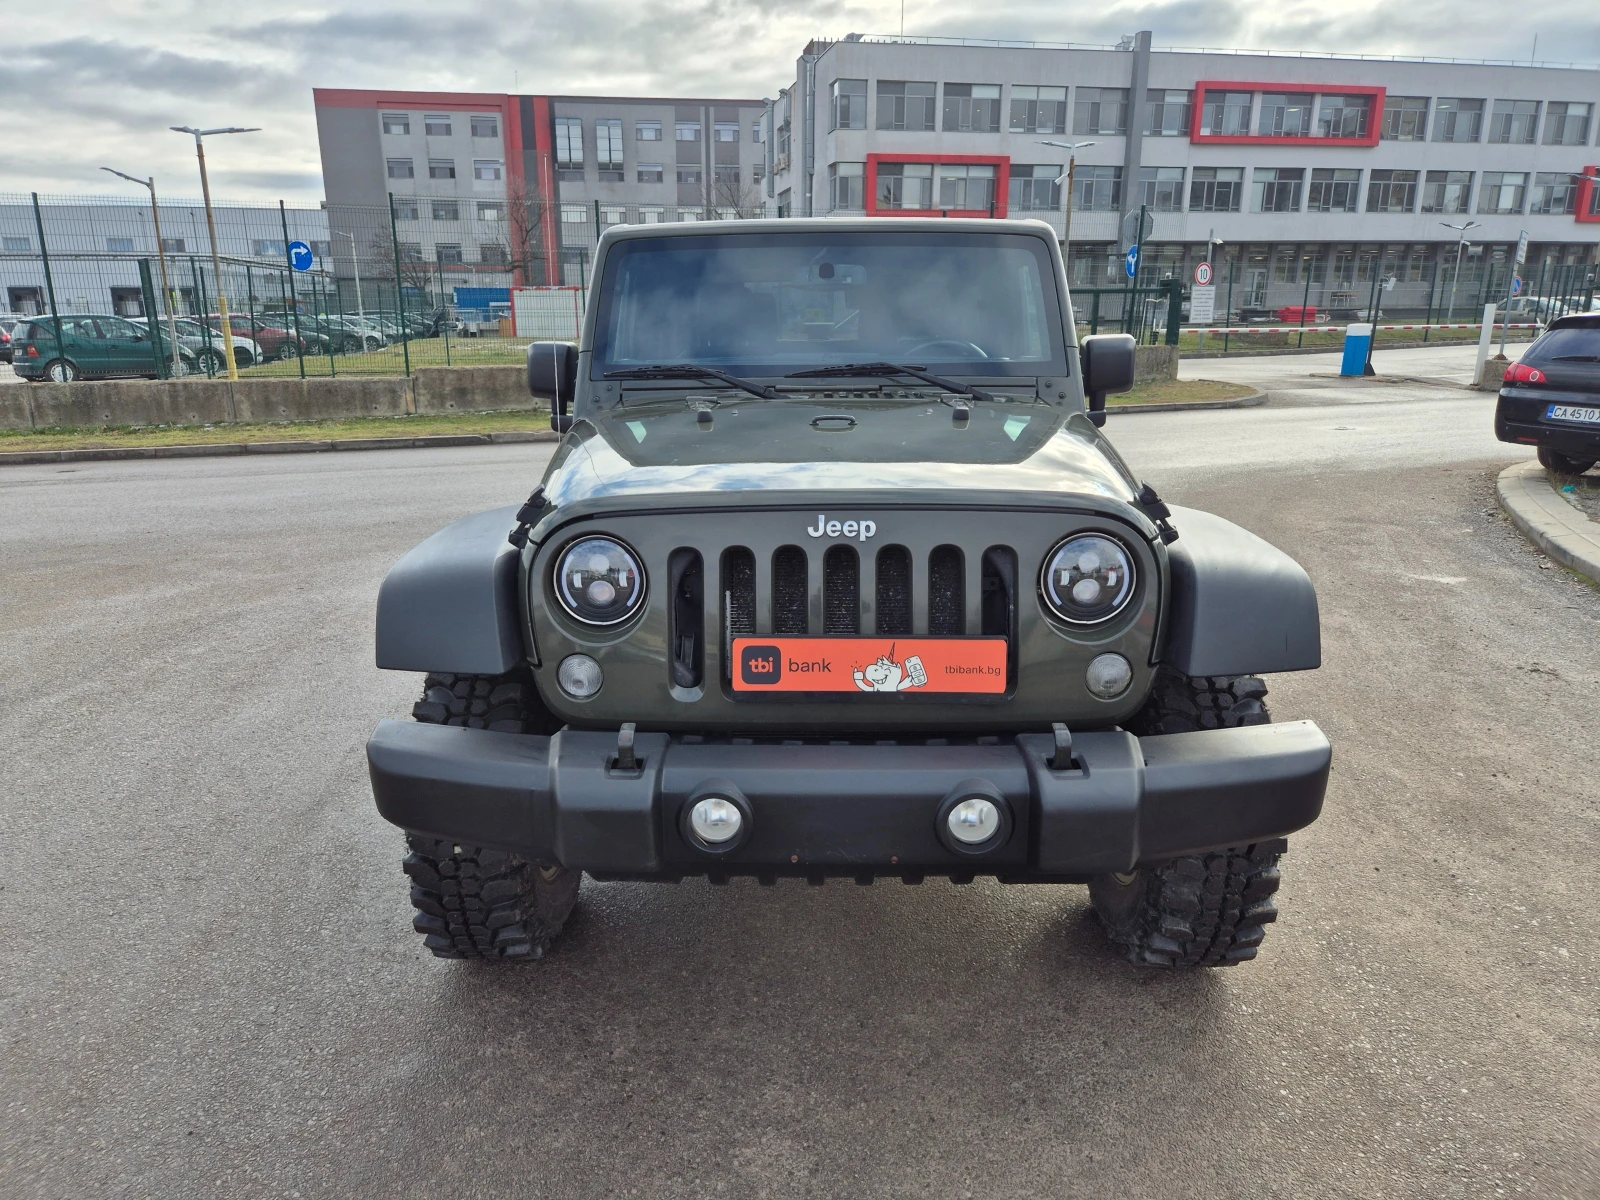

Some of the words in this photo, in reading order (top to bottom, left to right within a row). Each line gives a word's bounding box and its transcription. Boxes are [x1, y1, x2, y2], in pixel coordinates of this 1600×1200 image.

[1200, 268, 1208, 280] 10
[1570, 408, 1595, 420] 4510
[807, 515, 877, 542] Jeep
[748, 656, 774, 673] tbi
[788, 657, 832, 673] bank
[944, 665, 1001, 676] tbibank.bg
